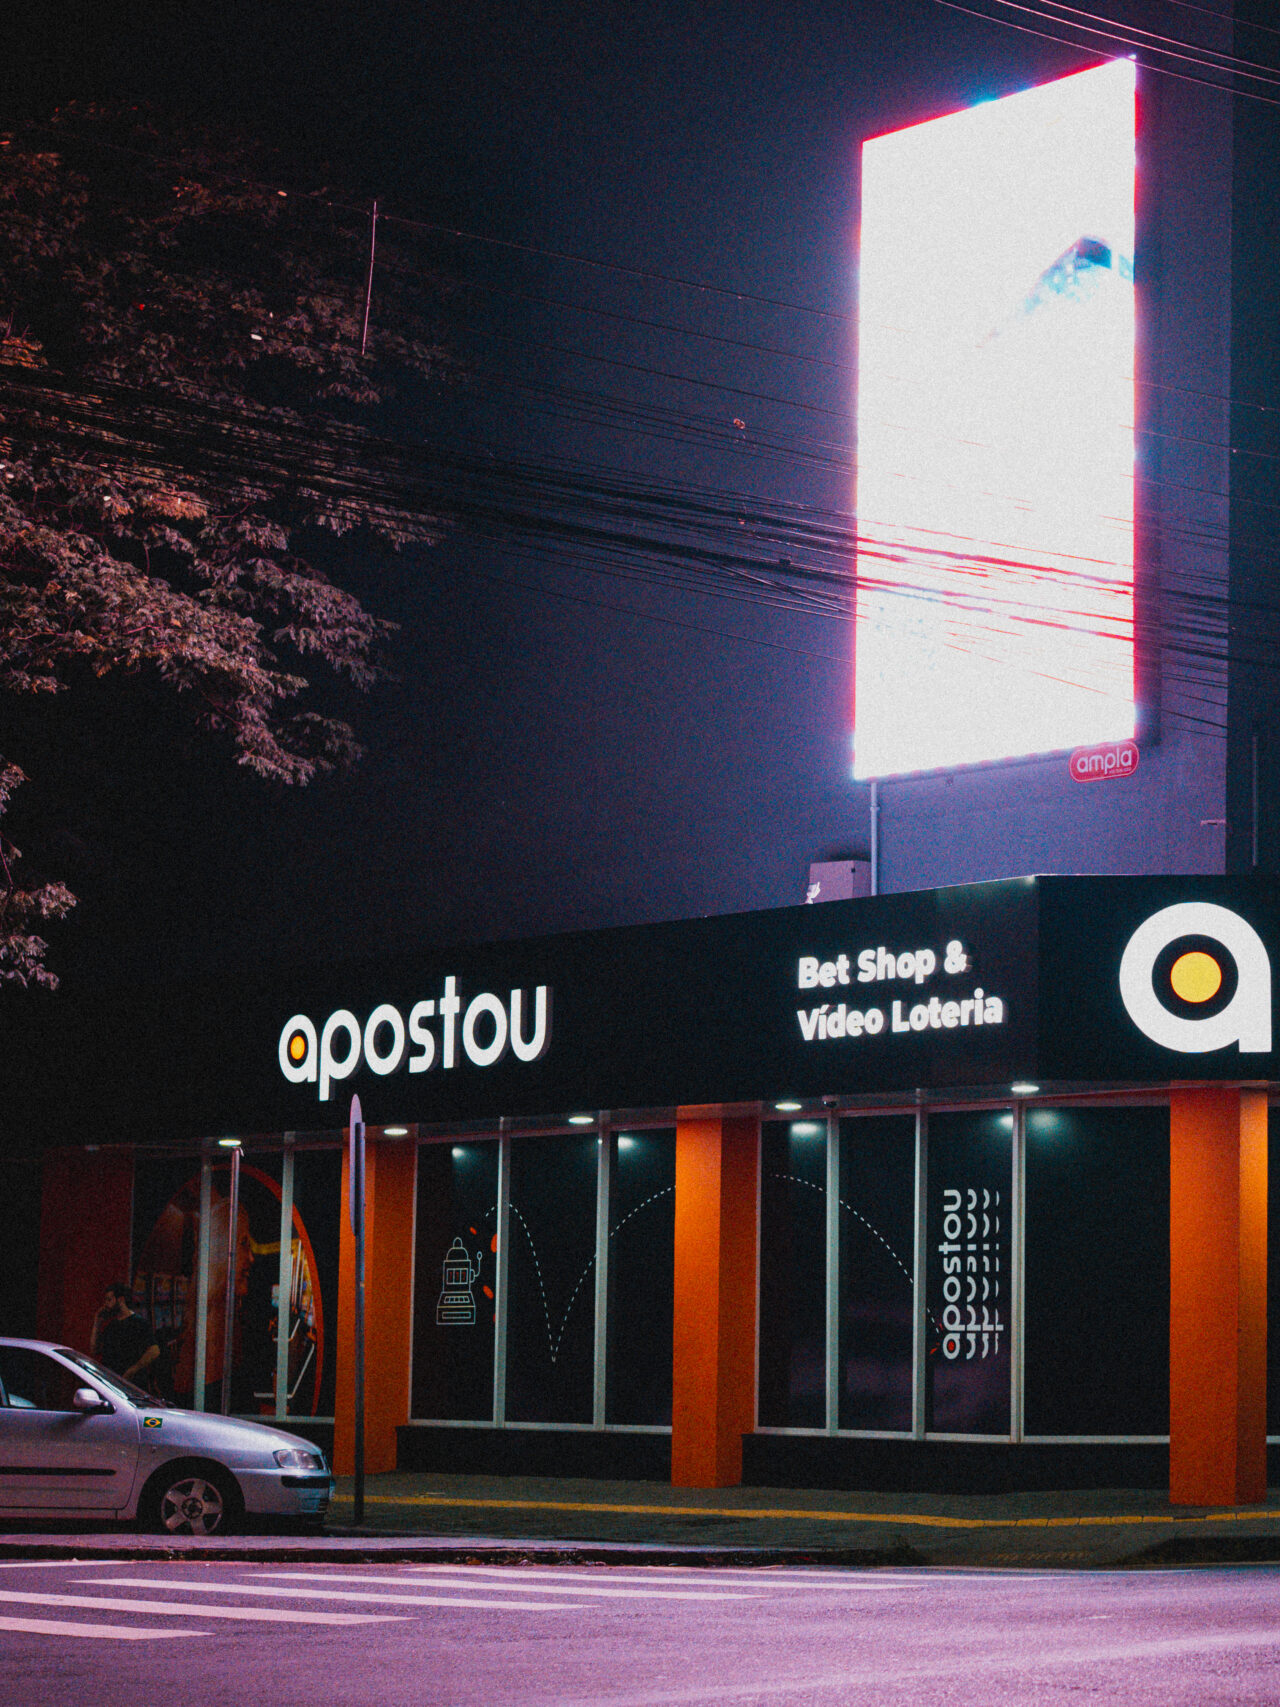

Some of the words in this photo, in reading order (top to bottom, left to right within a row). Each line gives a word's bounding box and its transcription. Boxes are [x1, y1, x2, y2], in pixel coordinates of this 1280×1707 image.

[1076, 747, 1132, 775] ampla
[798, 954, 850, 989] Bet
[857, 946, 936, 984] Shop
[944, 940, 969, 974] &
[1119, 902, 1272, 1053] a
[279, 976, 547, 1102] apostou
[797, 1004, 884, 1041] Vídeo
[892, 987, 1004, 1032] Loteria
[938, 1189, 966, 1360] apostou
